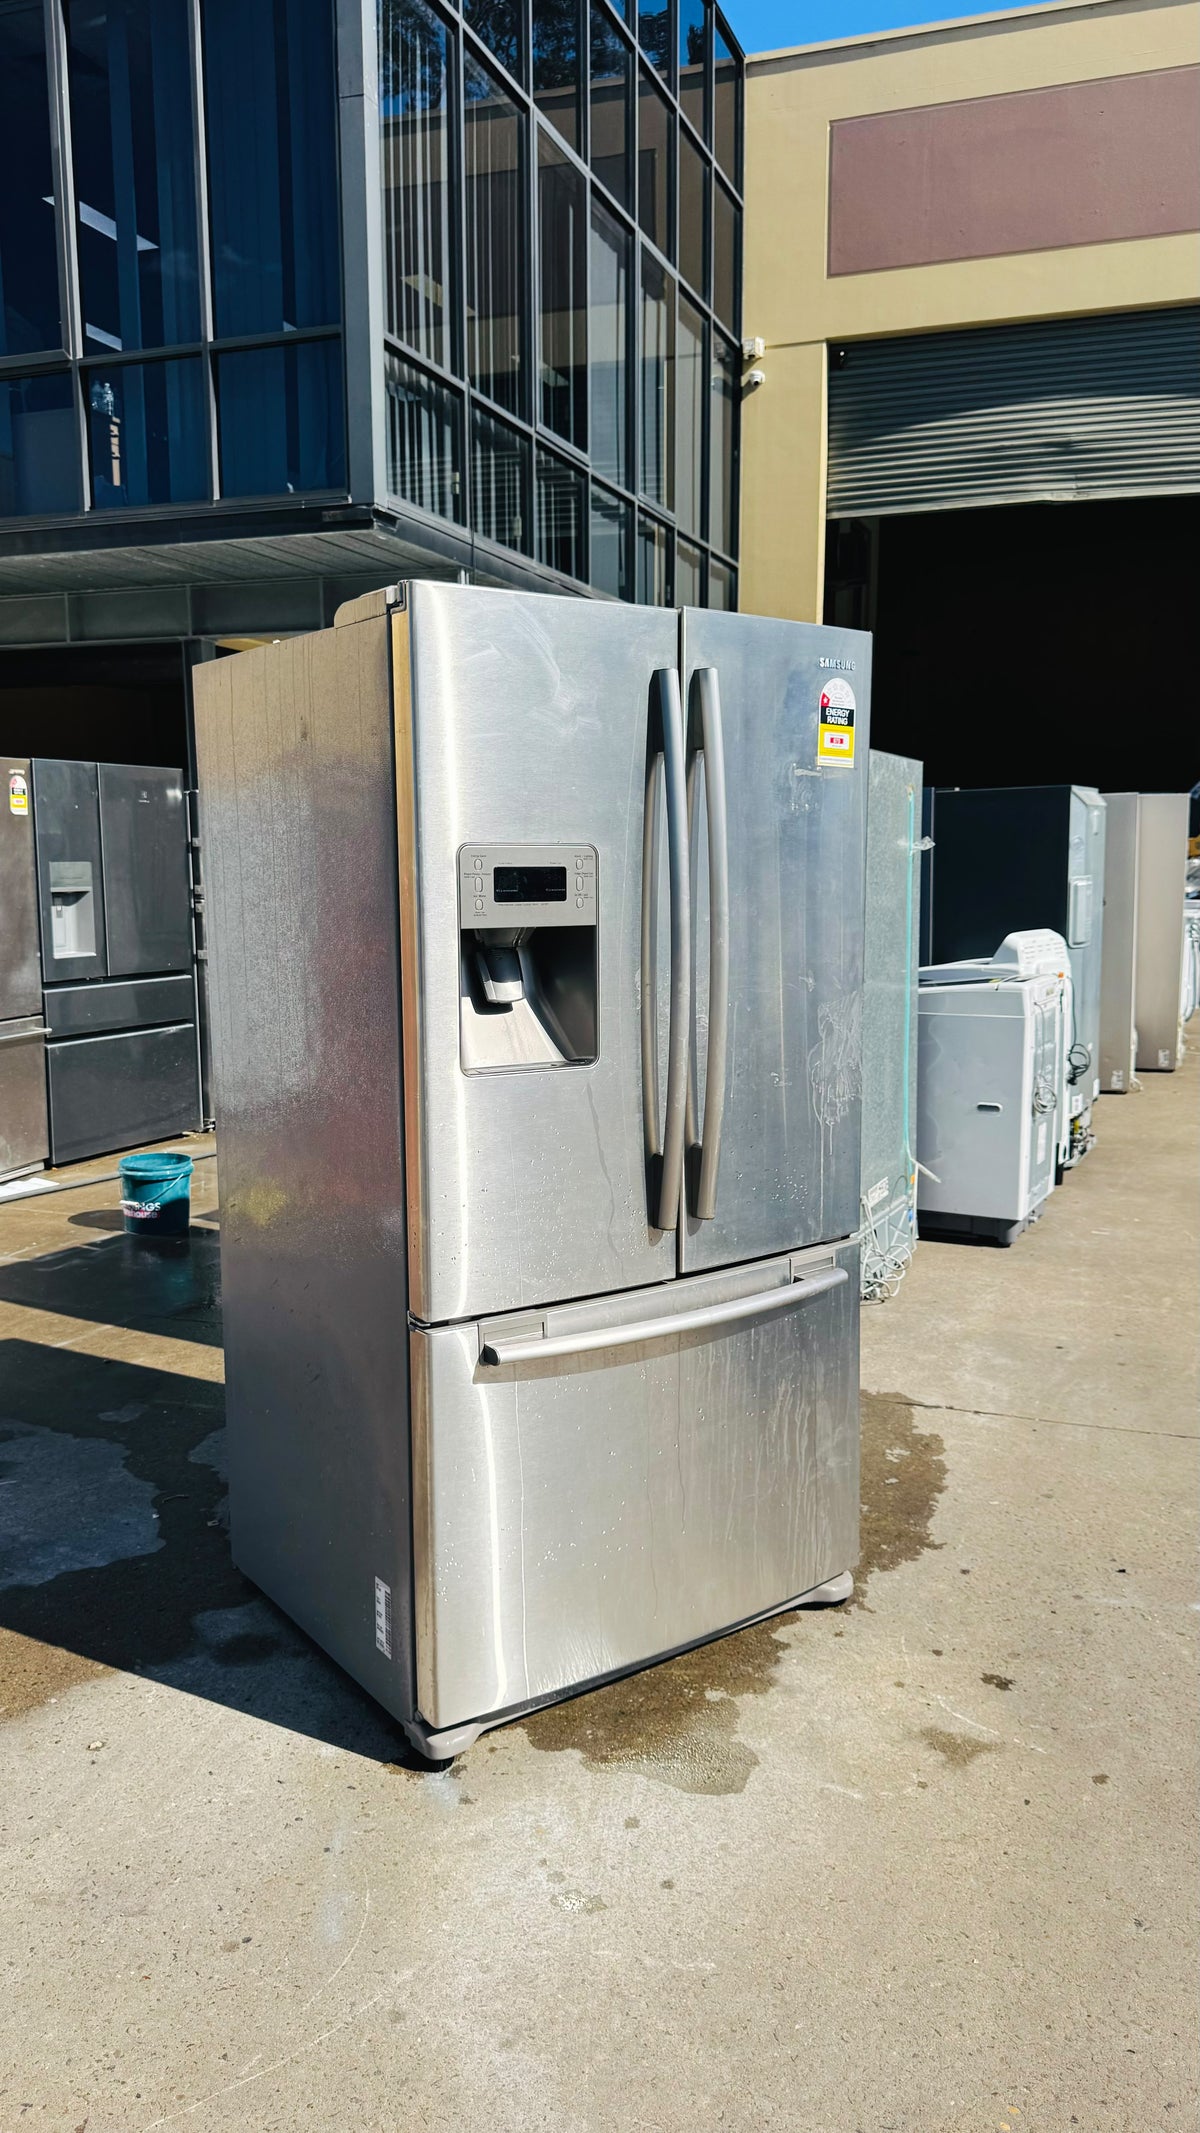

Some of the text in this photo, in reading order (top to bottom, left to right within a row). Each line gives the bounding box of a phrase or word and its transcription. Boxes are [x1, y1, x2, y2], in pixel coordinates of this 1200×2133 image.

[820, 658, 856, 670] SAMSUNG
[826, 708, 849, 718] ENERGY
[827, 716, 848, 725] RATING
